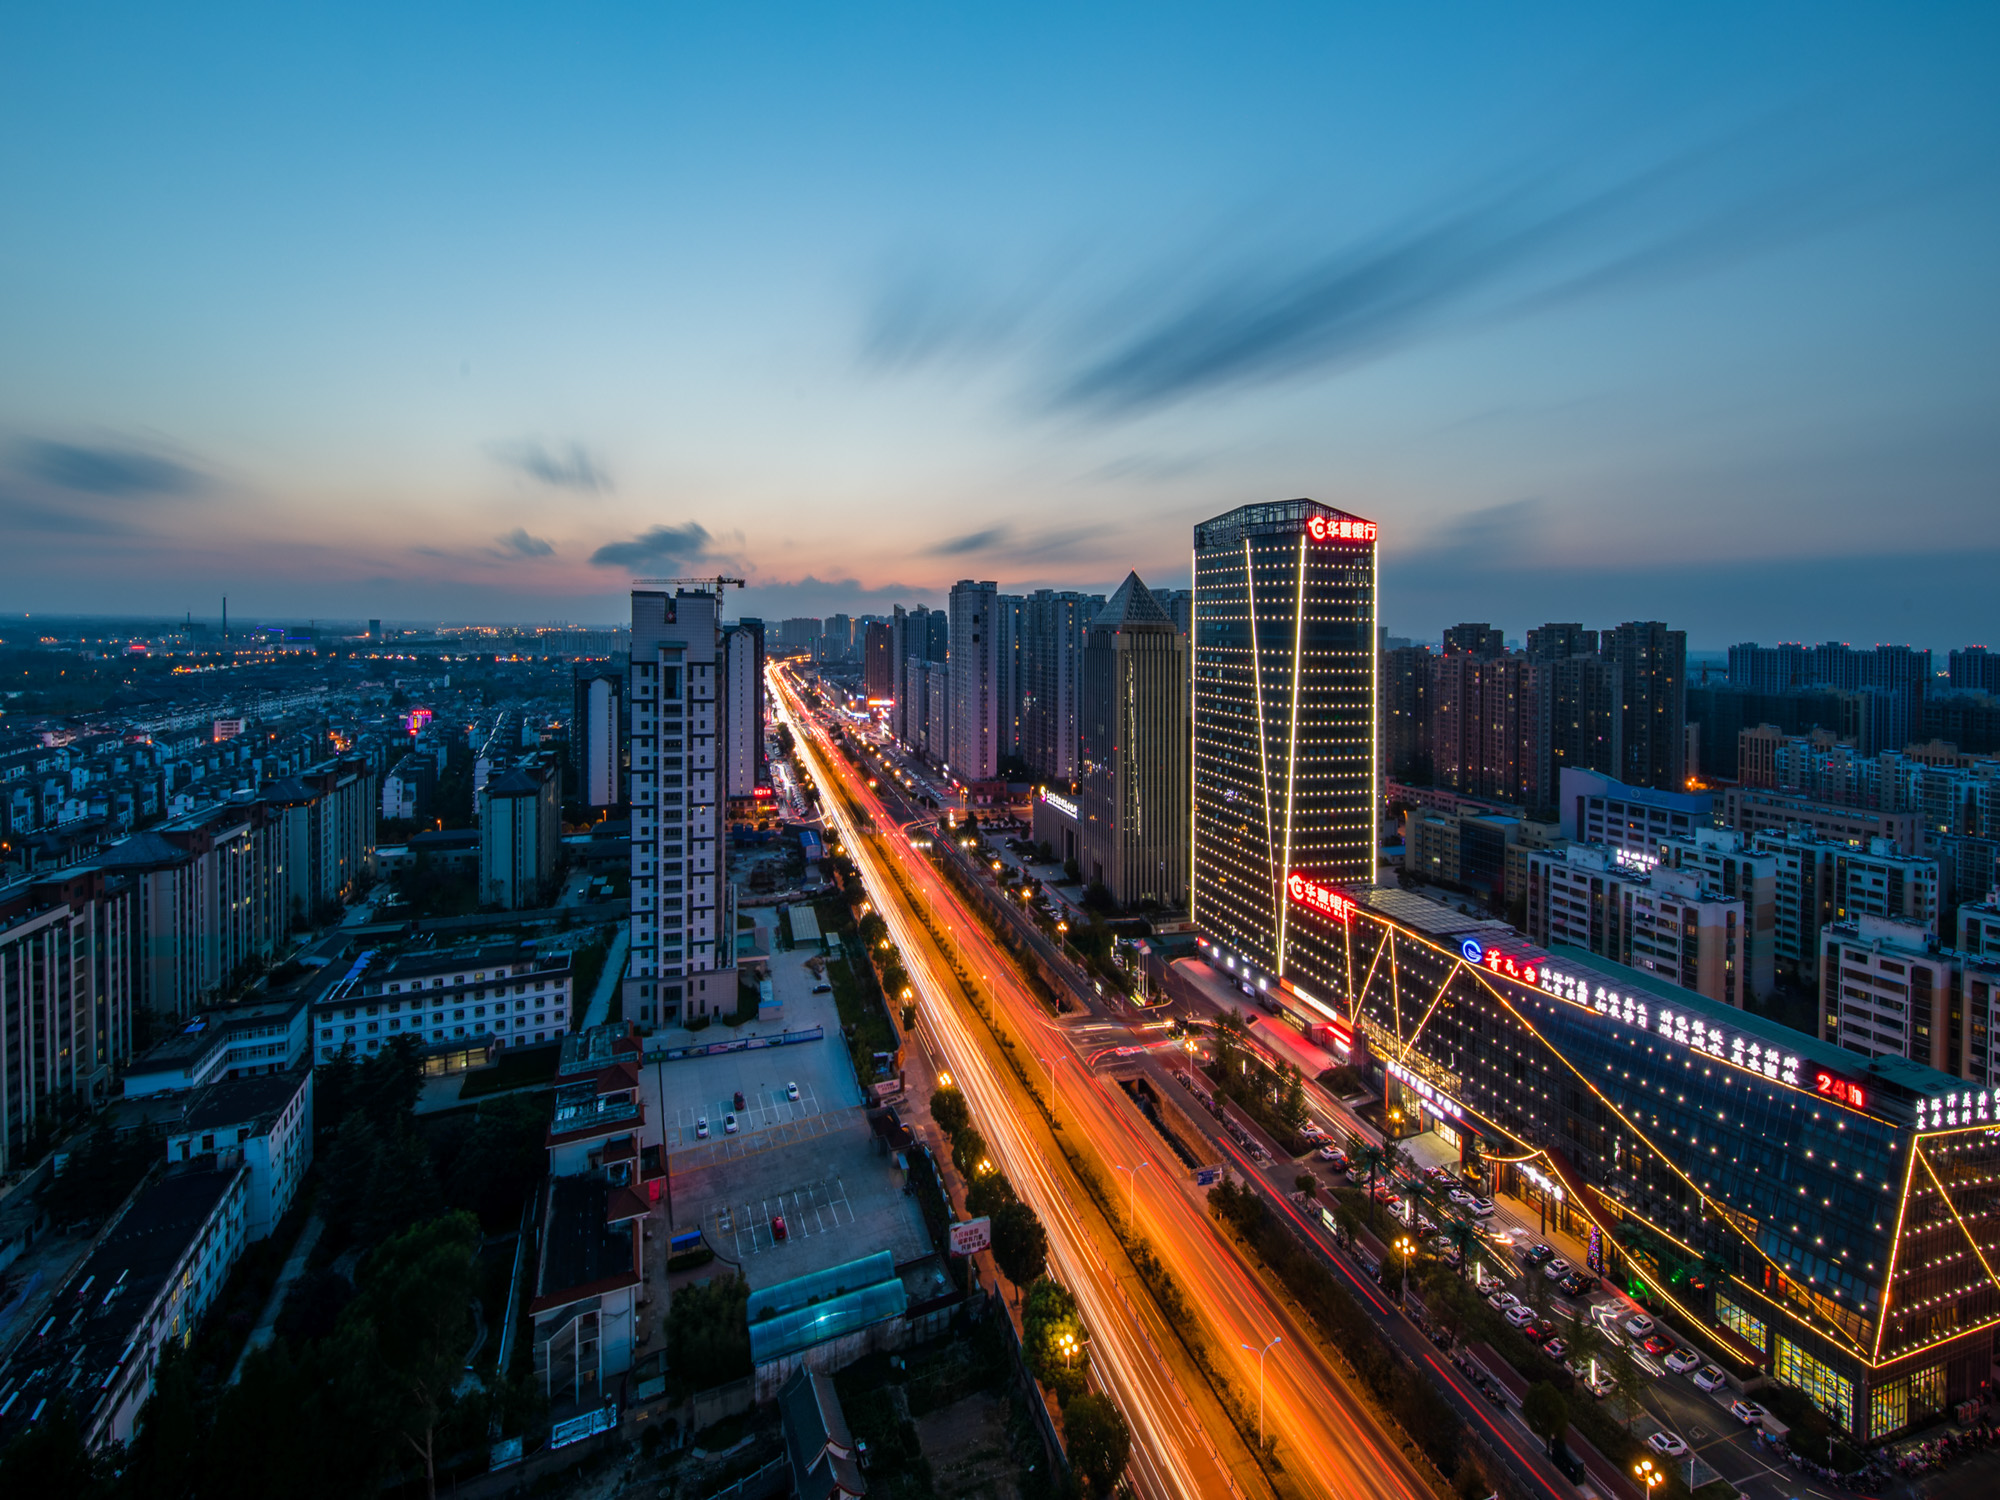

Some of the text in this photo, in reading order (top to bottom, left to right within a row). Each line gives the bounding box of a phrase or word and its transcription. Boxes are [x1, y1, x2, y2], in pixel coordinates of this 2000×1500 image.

[1326, 520, 1377, 540] 华夏银行
[1304, 882, 1356, 917] 华夏银行
[1306, 896, 1331, 913] HUAXIA
[1540, 979, 1588, 1005] 儿童乐园
[1387, 1060, 1433, 1099] BETTER
[1435, 1093, 1462, 1118] YOU
[1816, 1073, 1863, 1107] 24h
